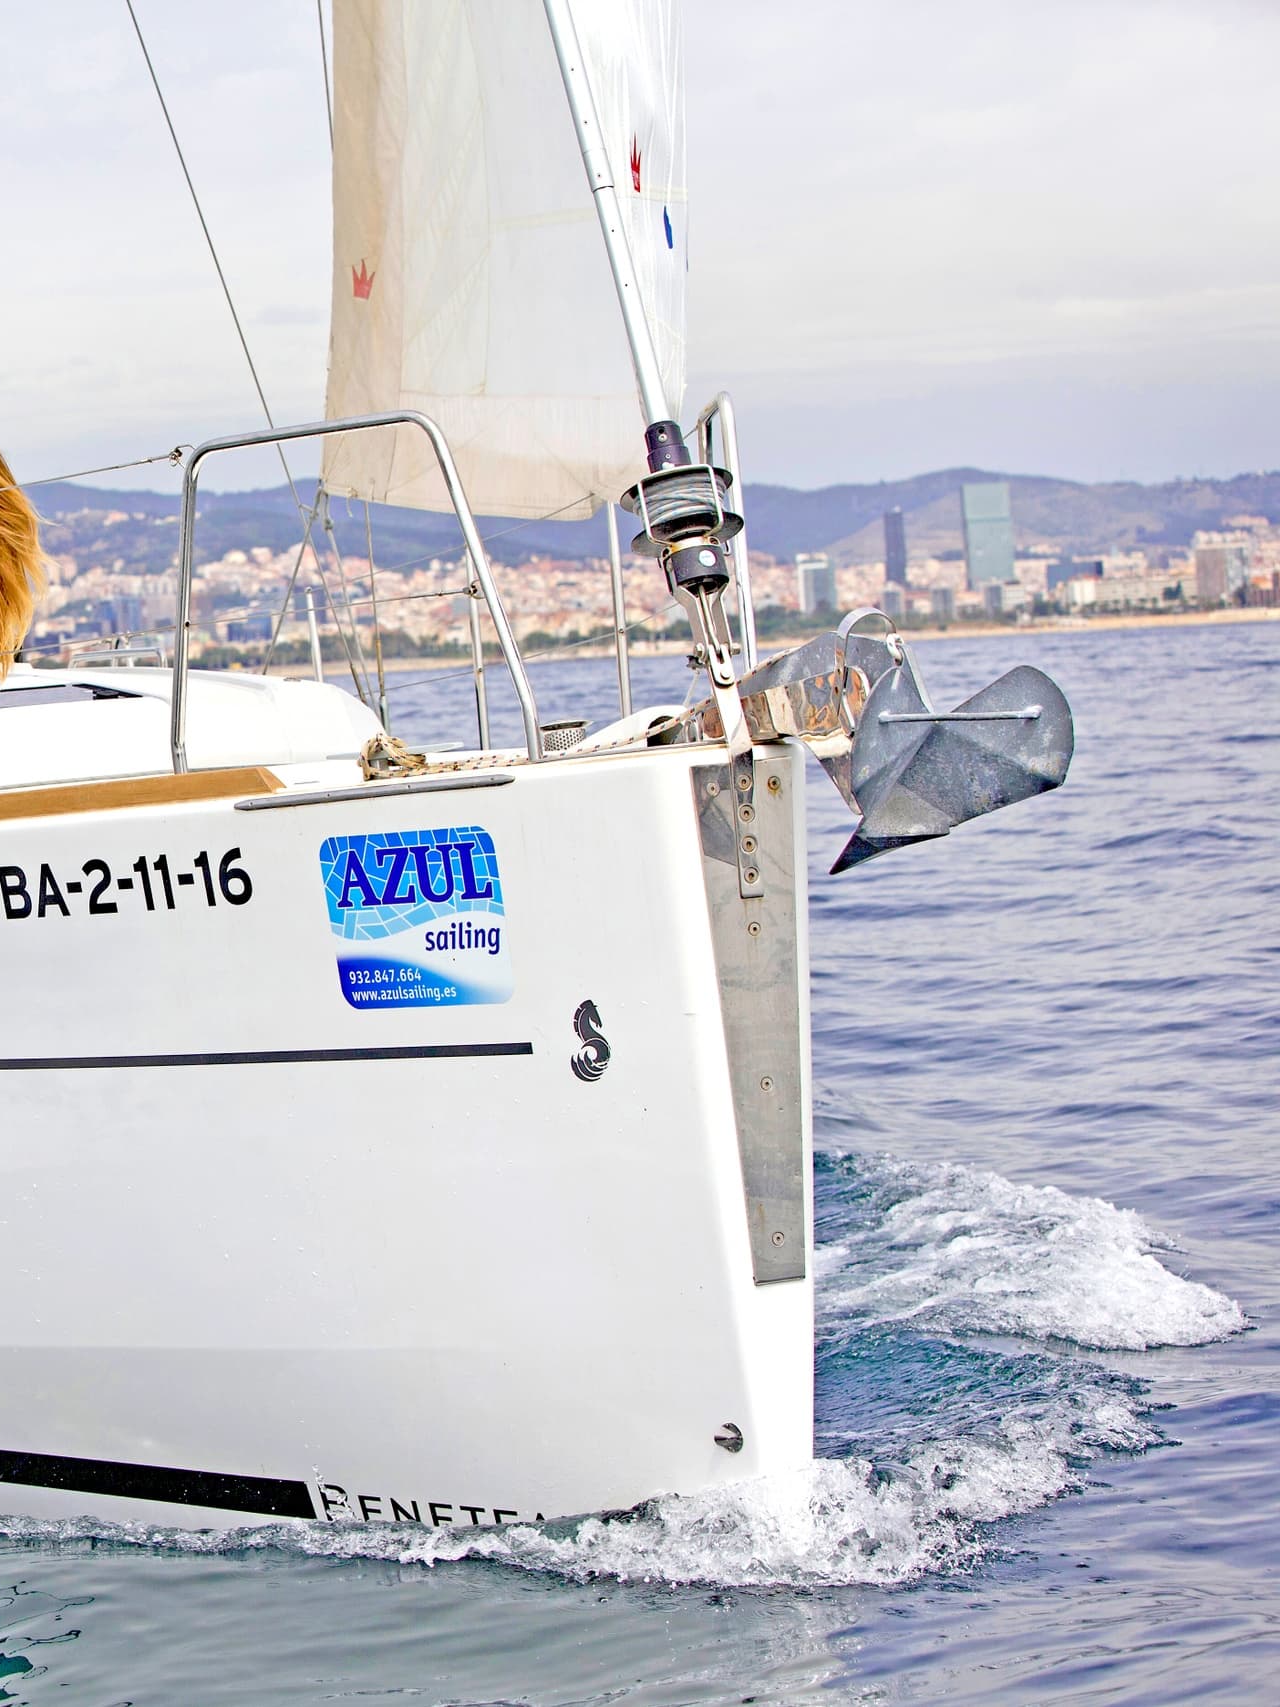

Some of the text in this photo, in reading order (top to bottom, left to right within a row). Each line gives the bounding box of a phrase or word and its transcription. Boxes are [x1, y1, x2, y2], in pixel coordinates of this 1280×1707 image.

[337, 842, 493, 908] AZUL
[425, 921, 500, 955] sailing
[349, 968, 421, 984] 932.847.664
[352, 984, 456, 1001] www.azulsailing.es
